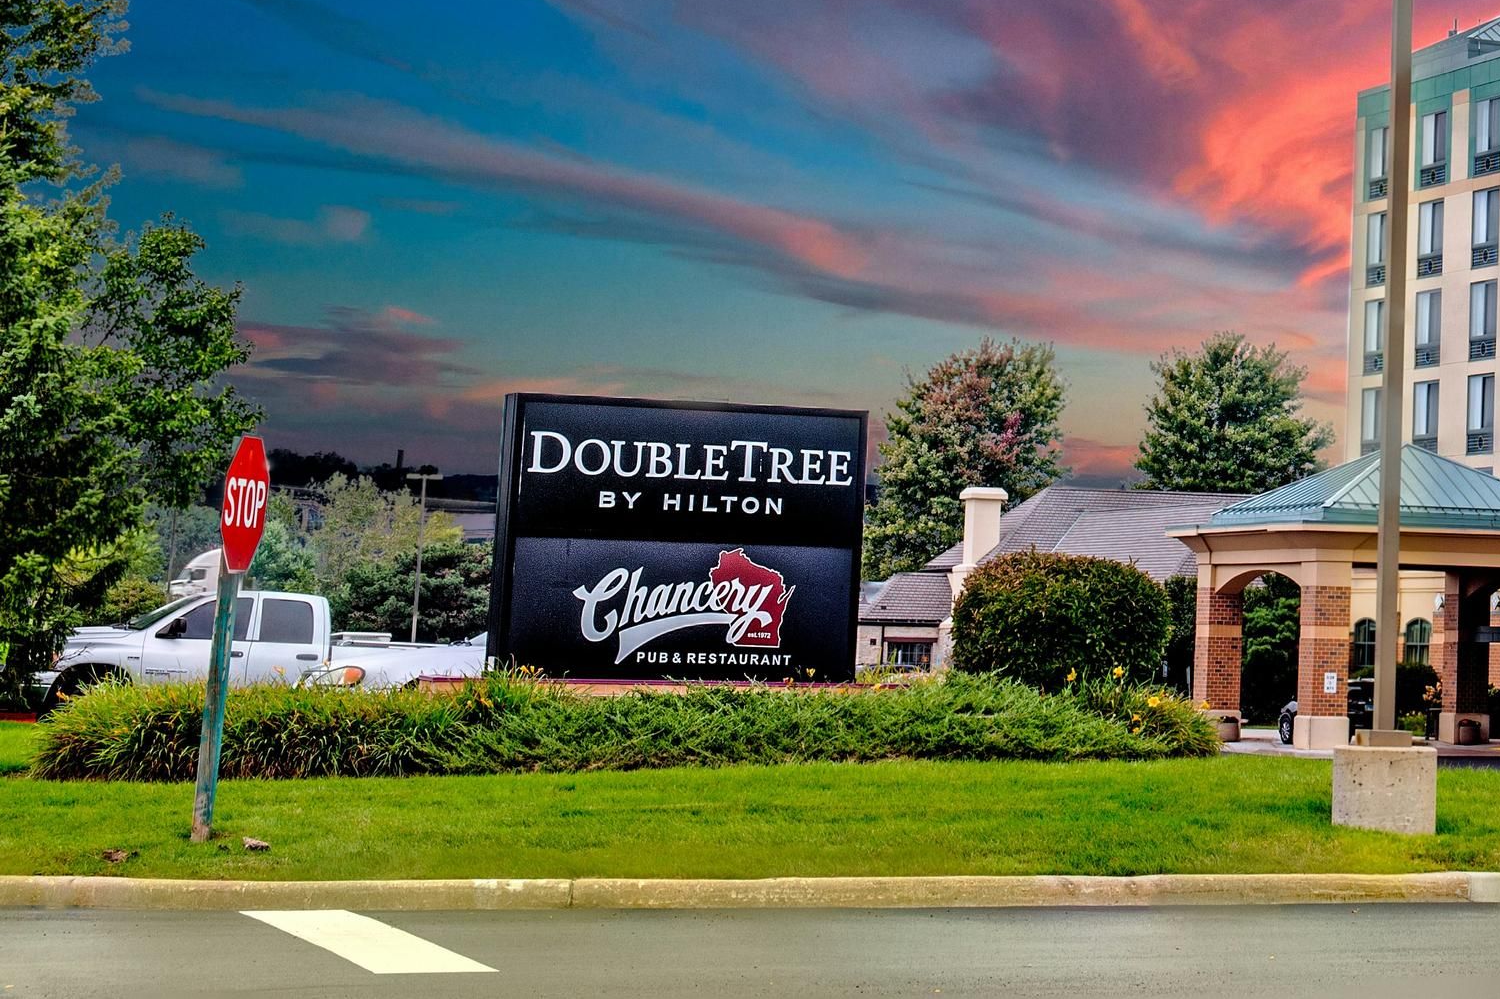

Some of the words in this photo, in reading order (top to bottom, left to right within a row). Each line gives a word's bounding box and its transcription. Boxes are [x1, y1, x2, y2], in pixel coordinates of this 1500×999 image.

[527, 431, 853, 486] DOUBLETREE
[224, 476, 266, 528] STOP
[598, 491, 642, 509] BY
[662, 493, 783, 515] HILTON
[572, 566, 773, 644] Chancery
[636, 651, 668, 663] PUB
[672, 652, 682, 664] &
[686, 653, 791, 666] RESTAURANT
